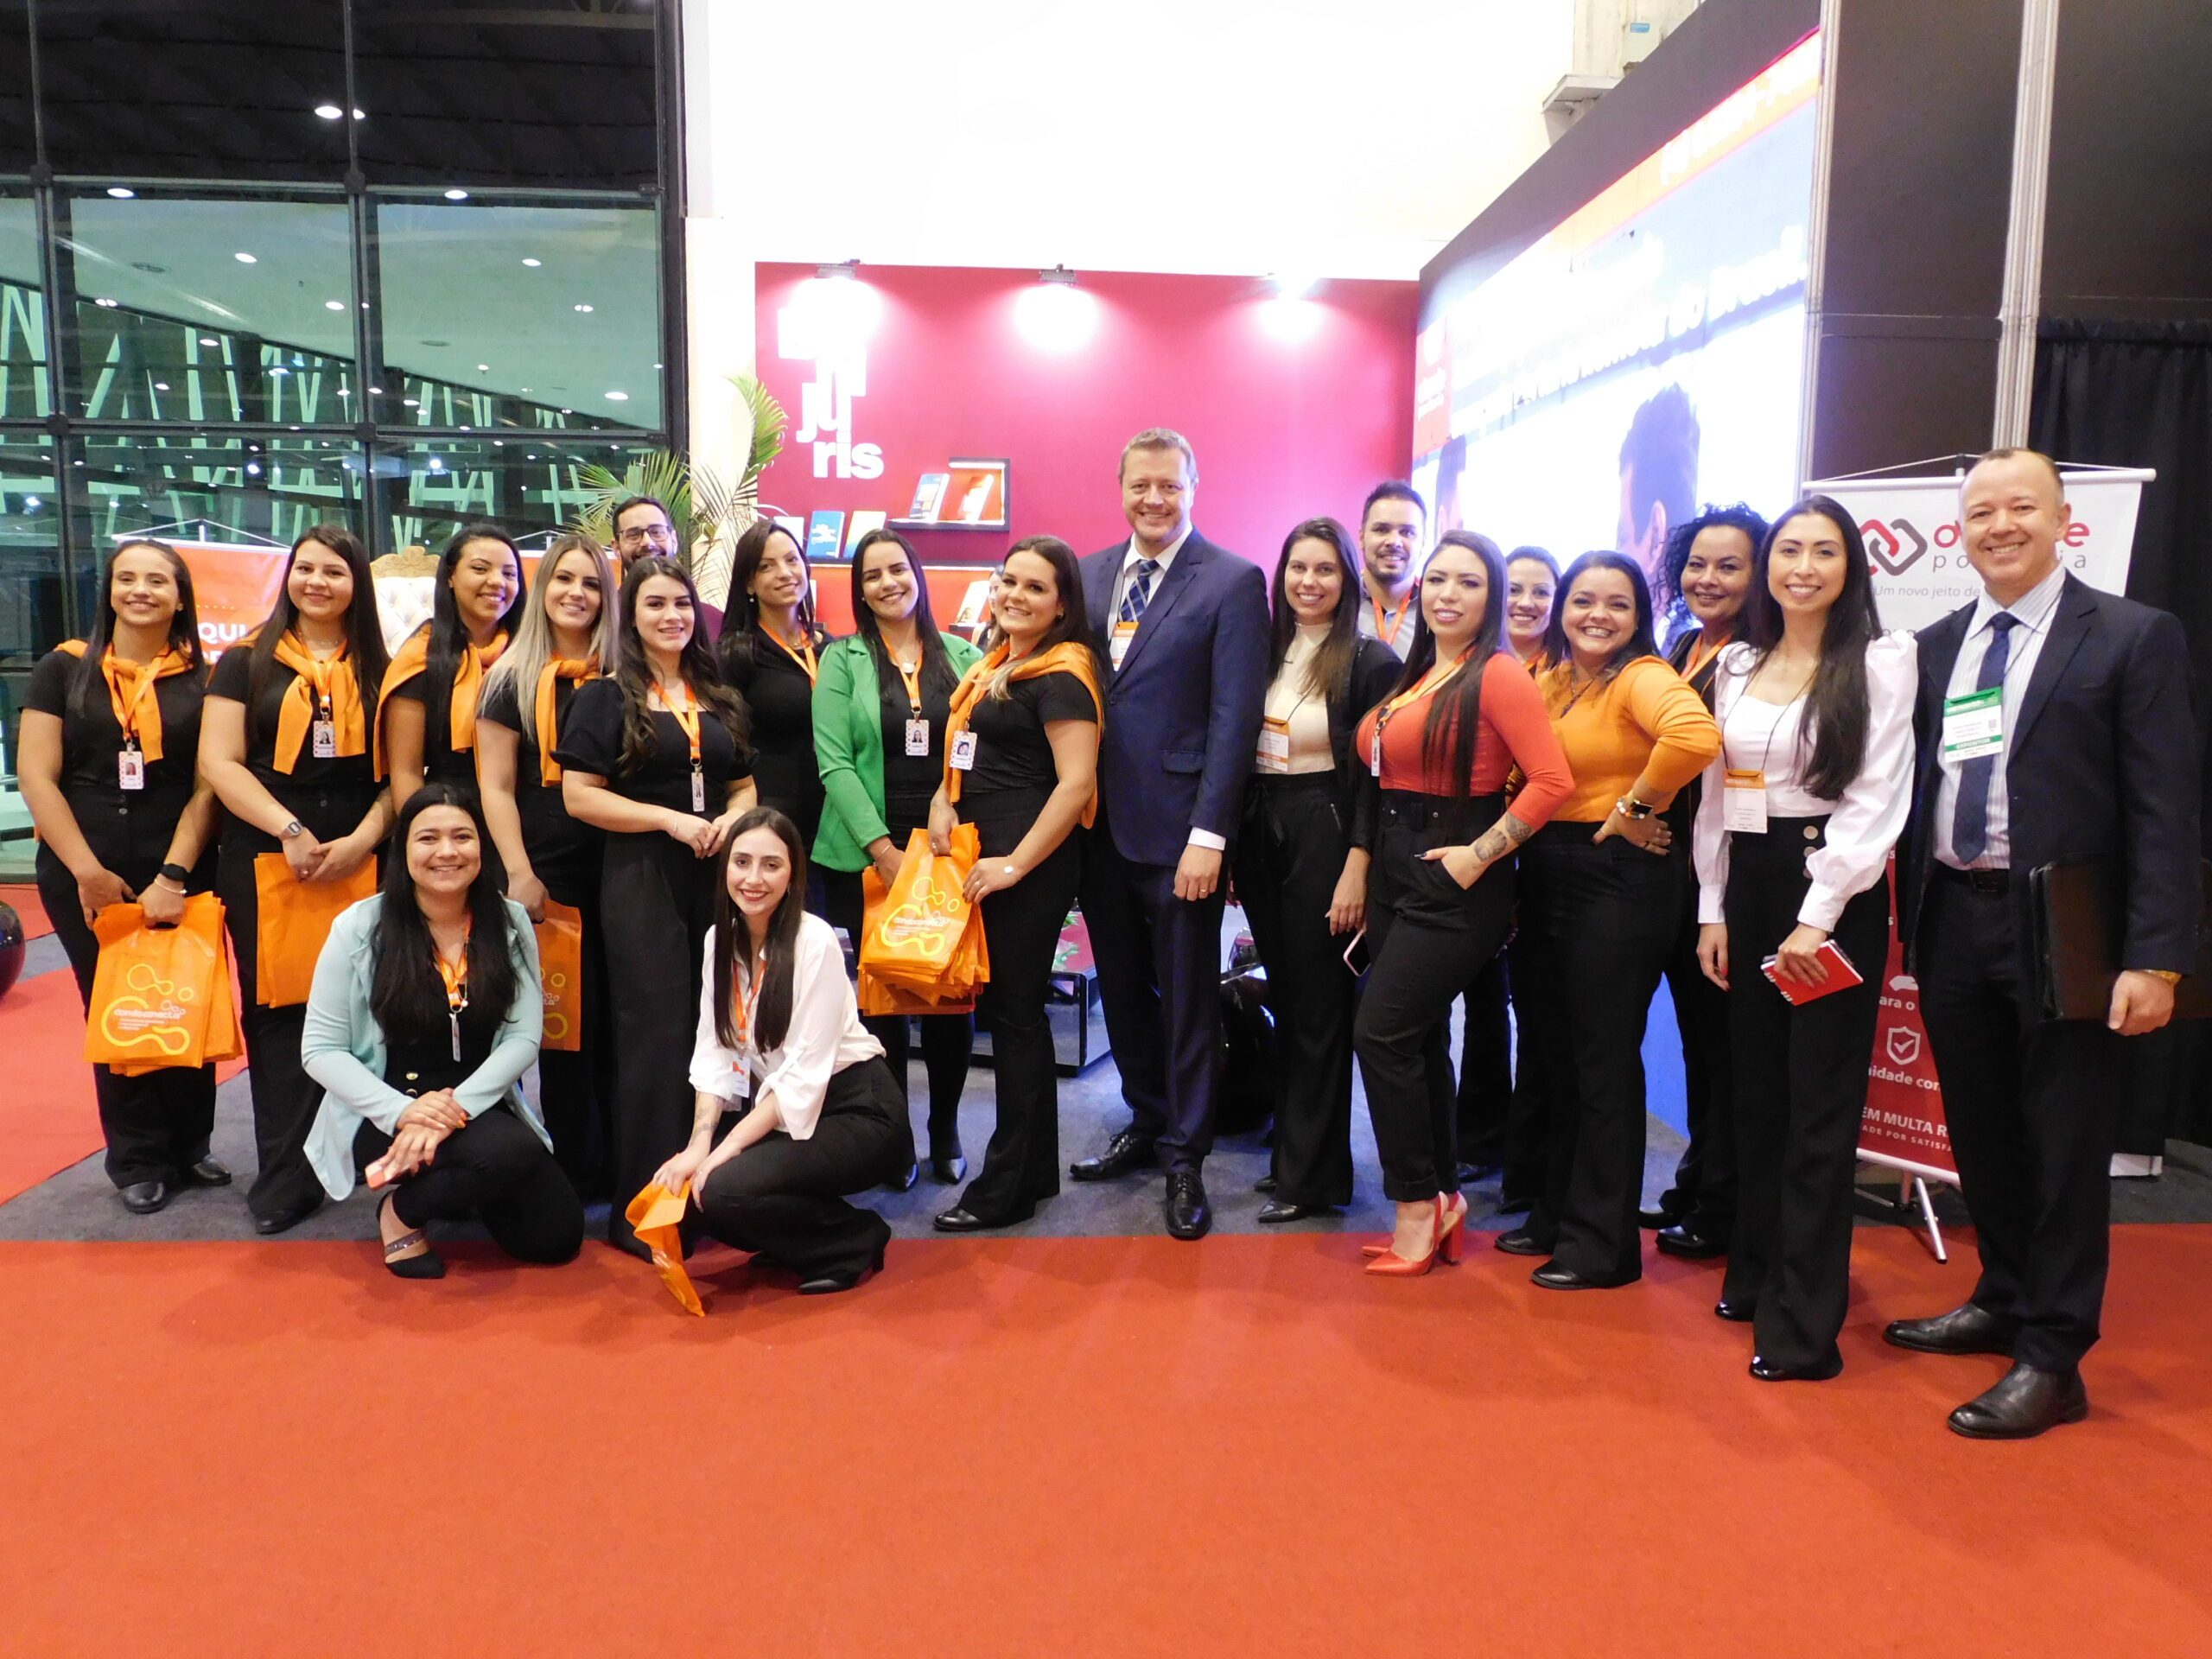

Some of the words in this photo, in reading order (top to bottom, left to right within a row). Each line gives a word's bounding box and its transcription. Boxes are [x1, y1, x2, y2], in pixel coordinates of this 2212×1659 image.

[1874, 585, 1895, 596] Um
[1897, 587, 1929, 596] novo
[1930, 585, 1961, 600] jeito
[1964, 585, 1981, 597] de
[1884, 1111, 1934, 1135] MULTA
[1885, 1129, 1907, 1141] POR
